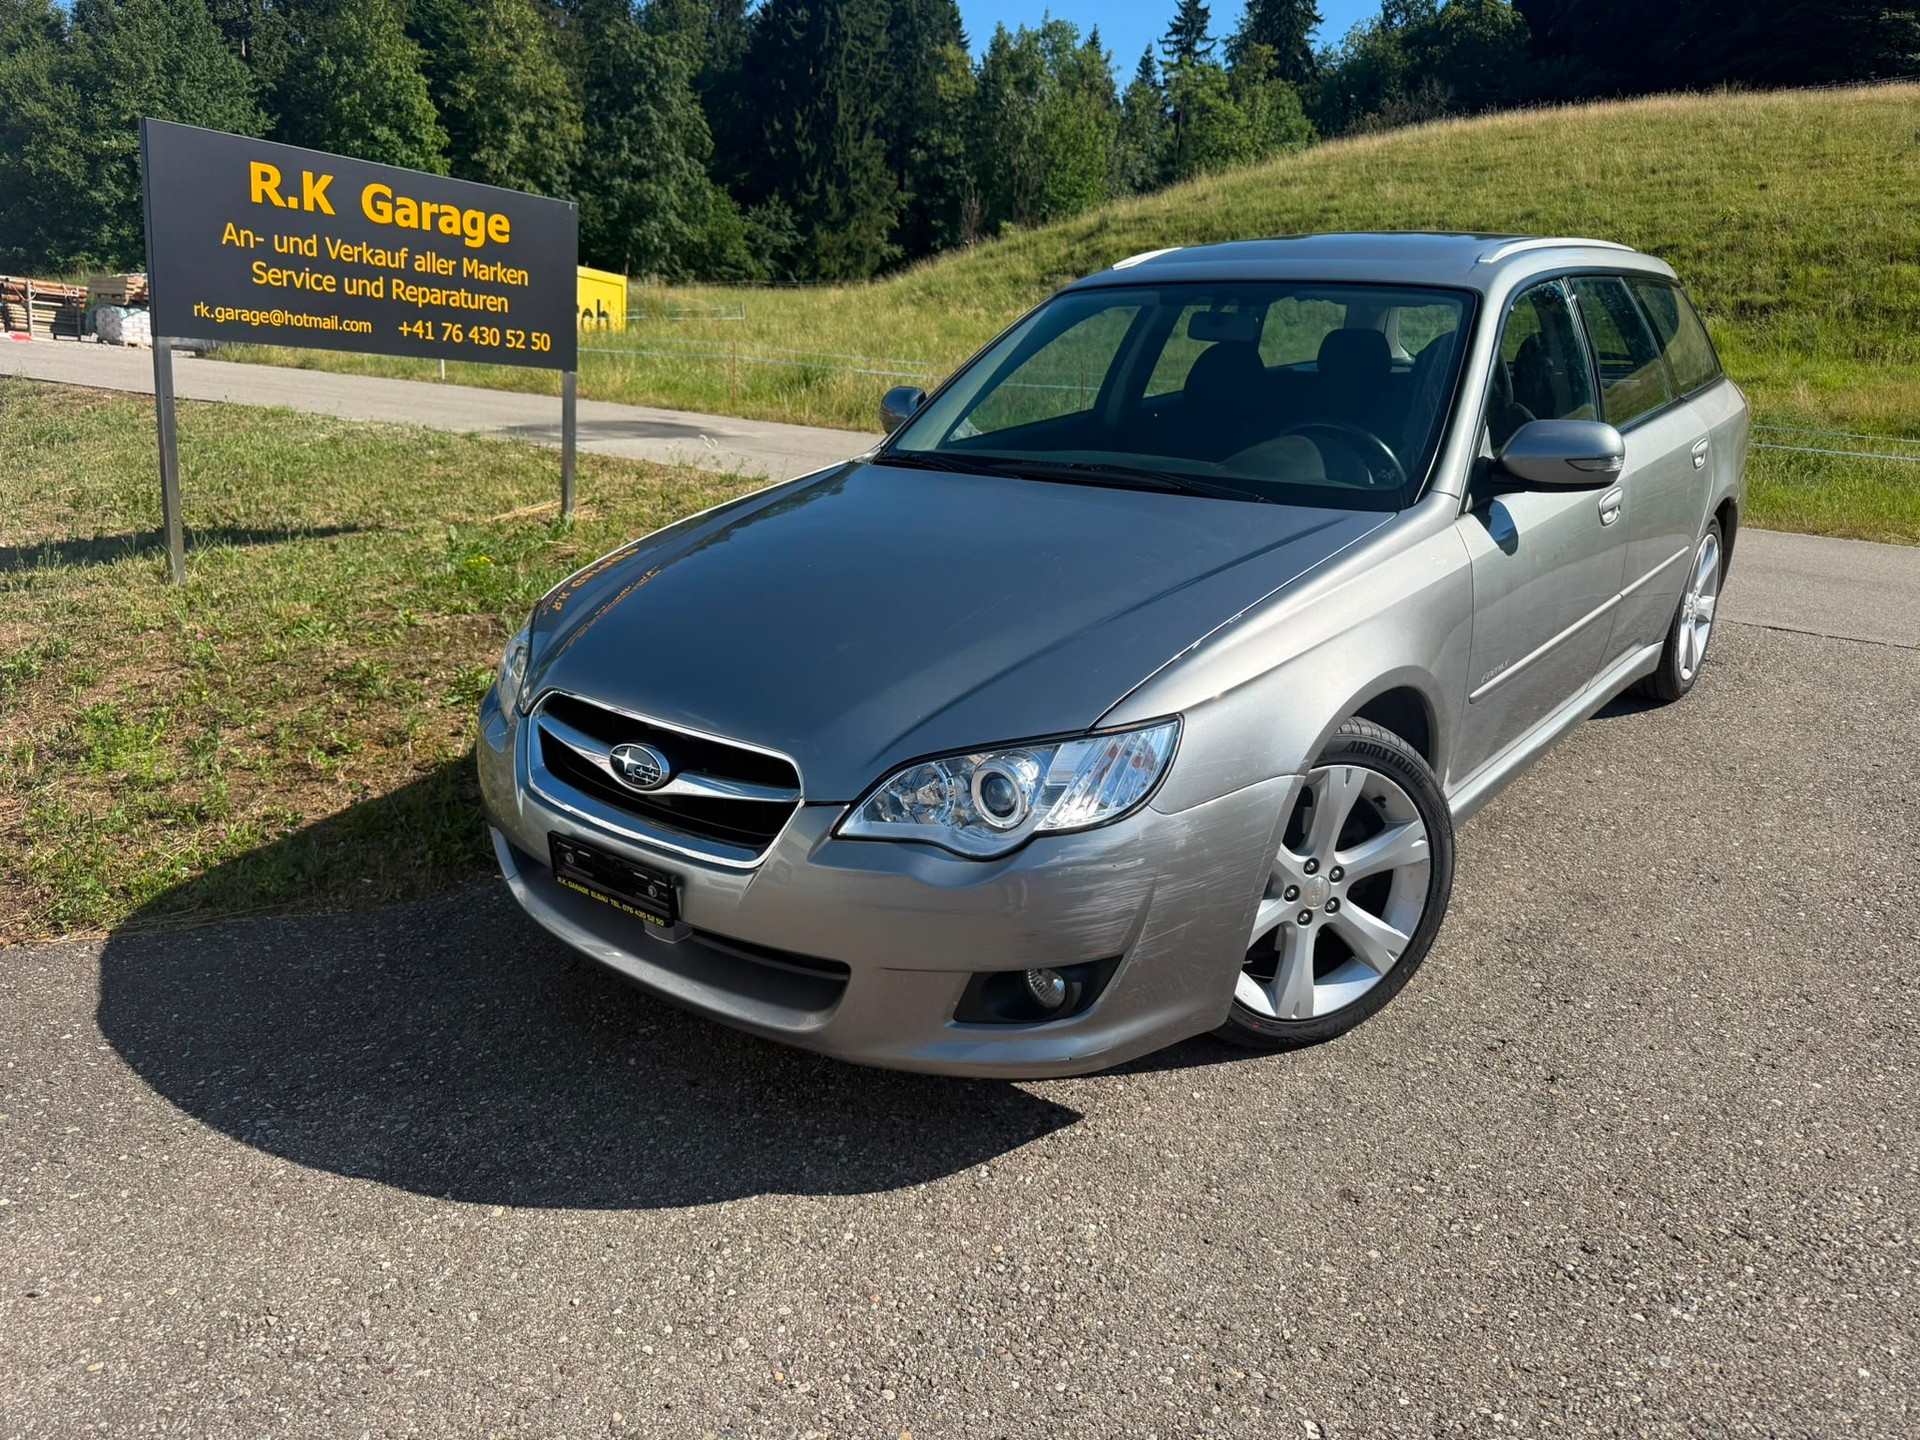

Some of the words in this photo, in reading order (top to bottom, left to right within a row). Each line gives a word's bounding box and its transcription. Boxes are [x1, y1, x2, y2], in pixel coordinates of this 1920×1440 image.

[250, 161, 336, 216] R.K
[361, 183, 511, 249] Garage
[222, 222, 265, 250] An-
[273, 235, 319, 258] und
[325, 237, 410, 270] Verkauf
[413, 252, 458, 277] aller
[462, 257, 530, 286] Marken
[251, 260, 337, 294] Service
[343, 277, 385, 300] und
[391, 278, 510, 314] Reparaturen
[193, 303, 373, 334] rk.garage@hotmail.com
[398, 320, 435, 341] +41
[441, 321, 465, 345] 76
[467, 325, 502, 348] 430
[505, 328, 527, 351] 52
[530, 331, 553, 353] 50
[568, 881, 589, 895] GARAGE
